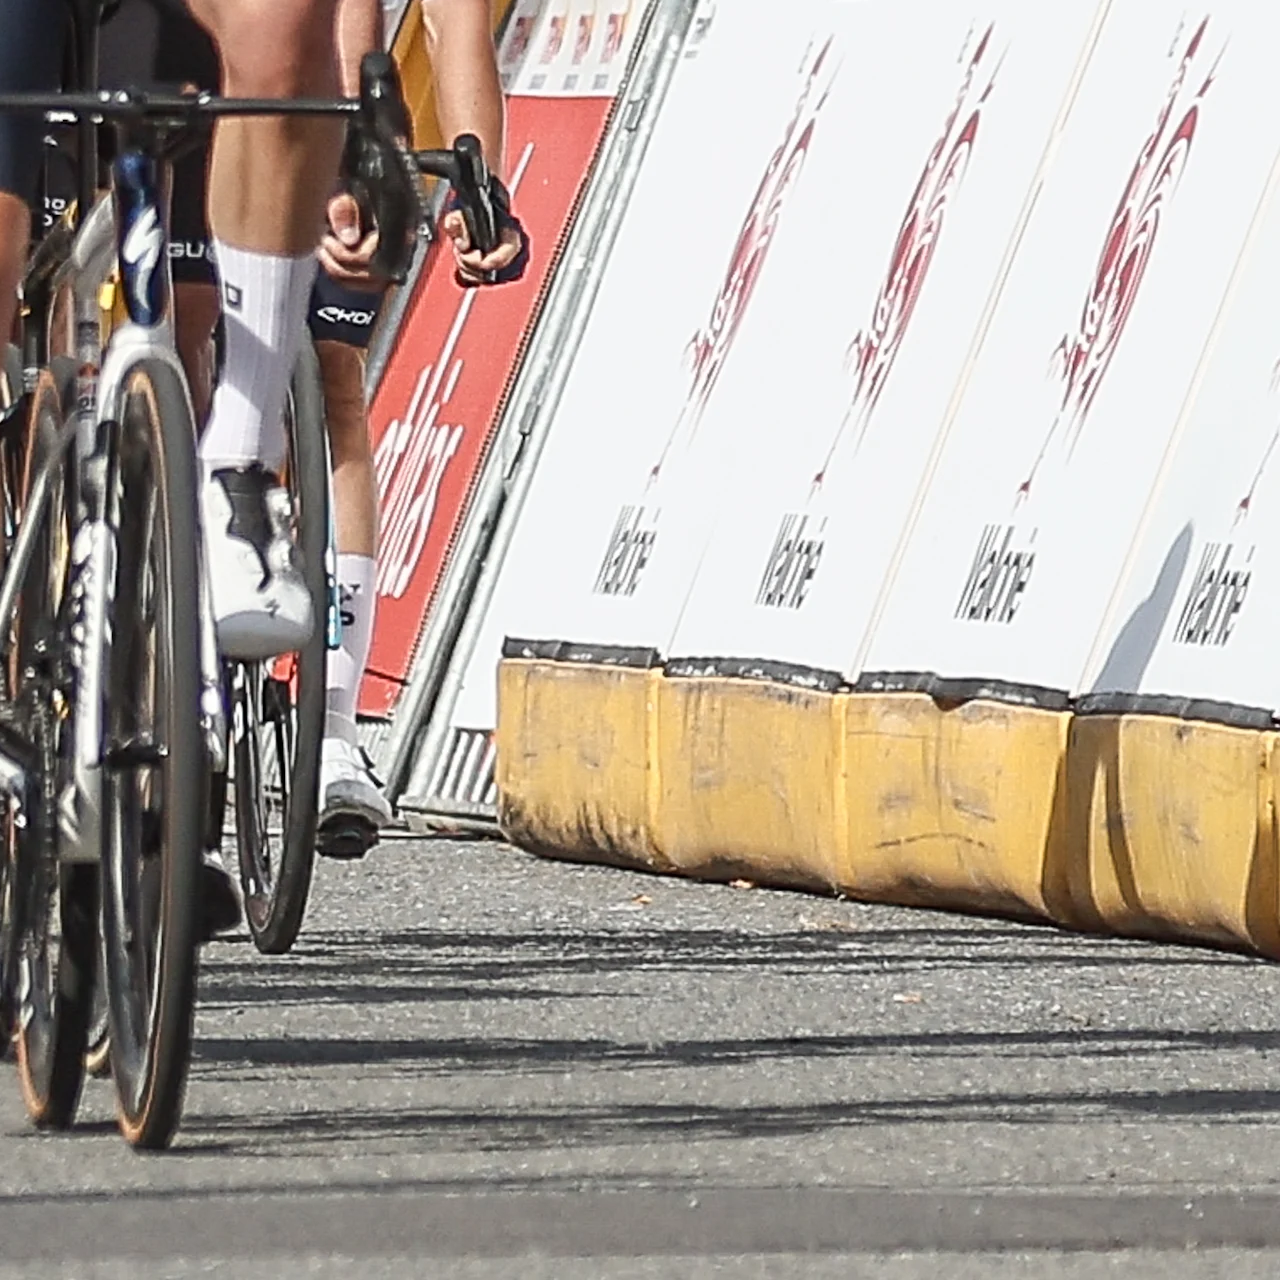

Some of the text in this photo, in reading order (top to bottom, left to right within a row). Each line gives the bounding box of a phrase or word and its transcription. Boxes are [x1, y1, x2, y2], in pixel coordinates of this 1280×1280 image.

[165, 241, 205, 258] GU
[754, 513, 828, 610] Wallonie
[954, 523, 1038, 625] Wallonie
[1172, 542, 1256, 646] Wallonie
